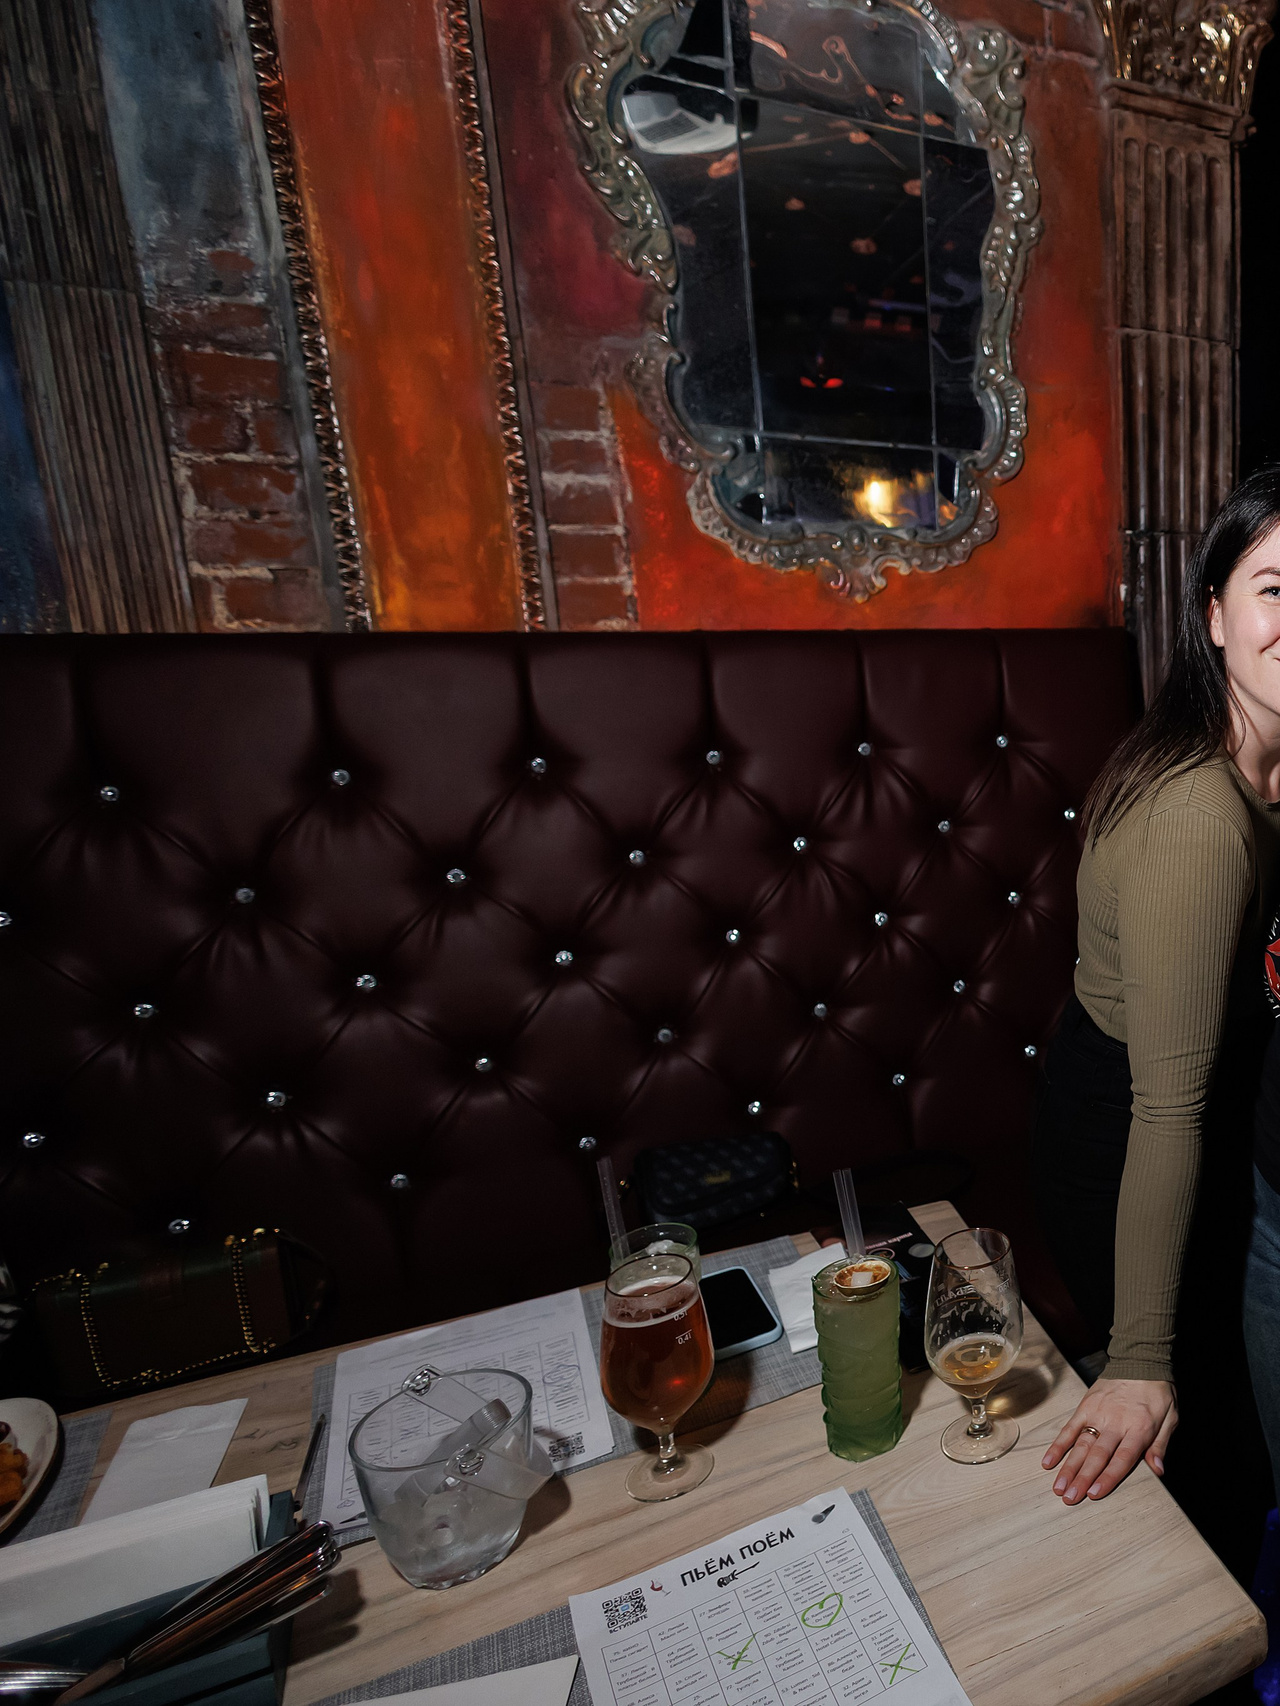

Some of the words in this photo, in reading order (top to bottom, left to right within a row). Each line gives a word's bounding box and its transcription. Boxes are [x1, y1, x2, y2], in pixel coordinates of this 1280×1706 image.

[680, 1554, 735, 1586] ПЬЁМ
[739, 1527, 795, 1560] ПОЁМ
[609, 1614, 648, 1634] ВСТУПАЙТЕ
